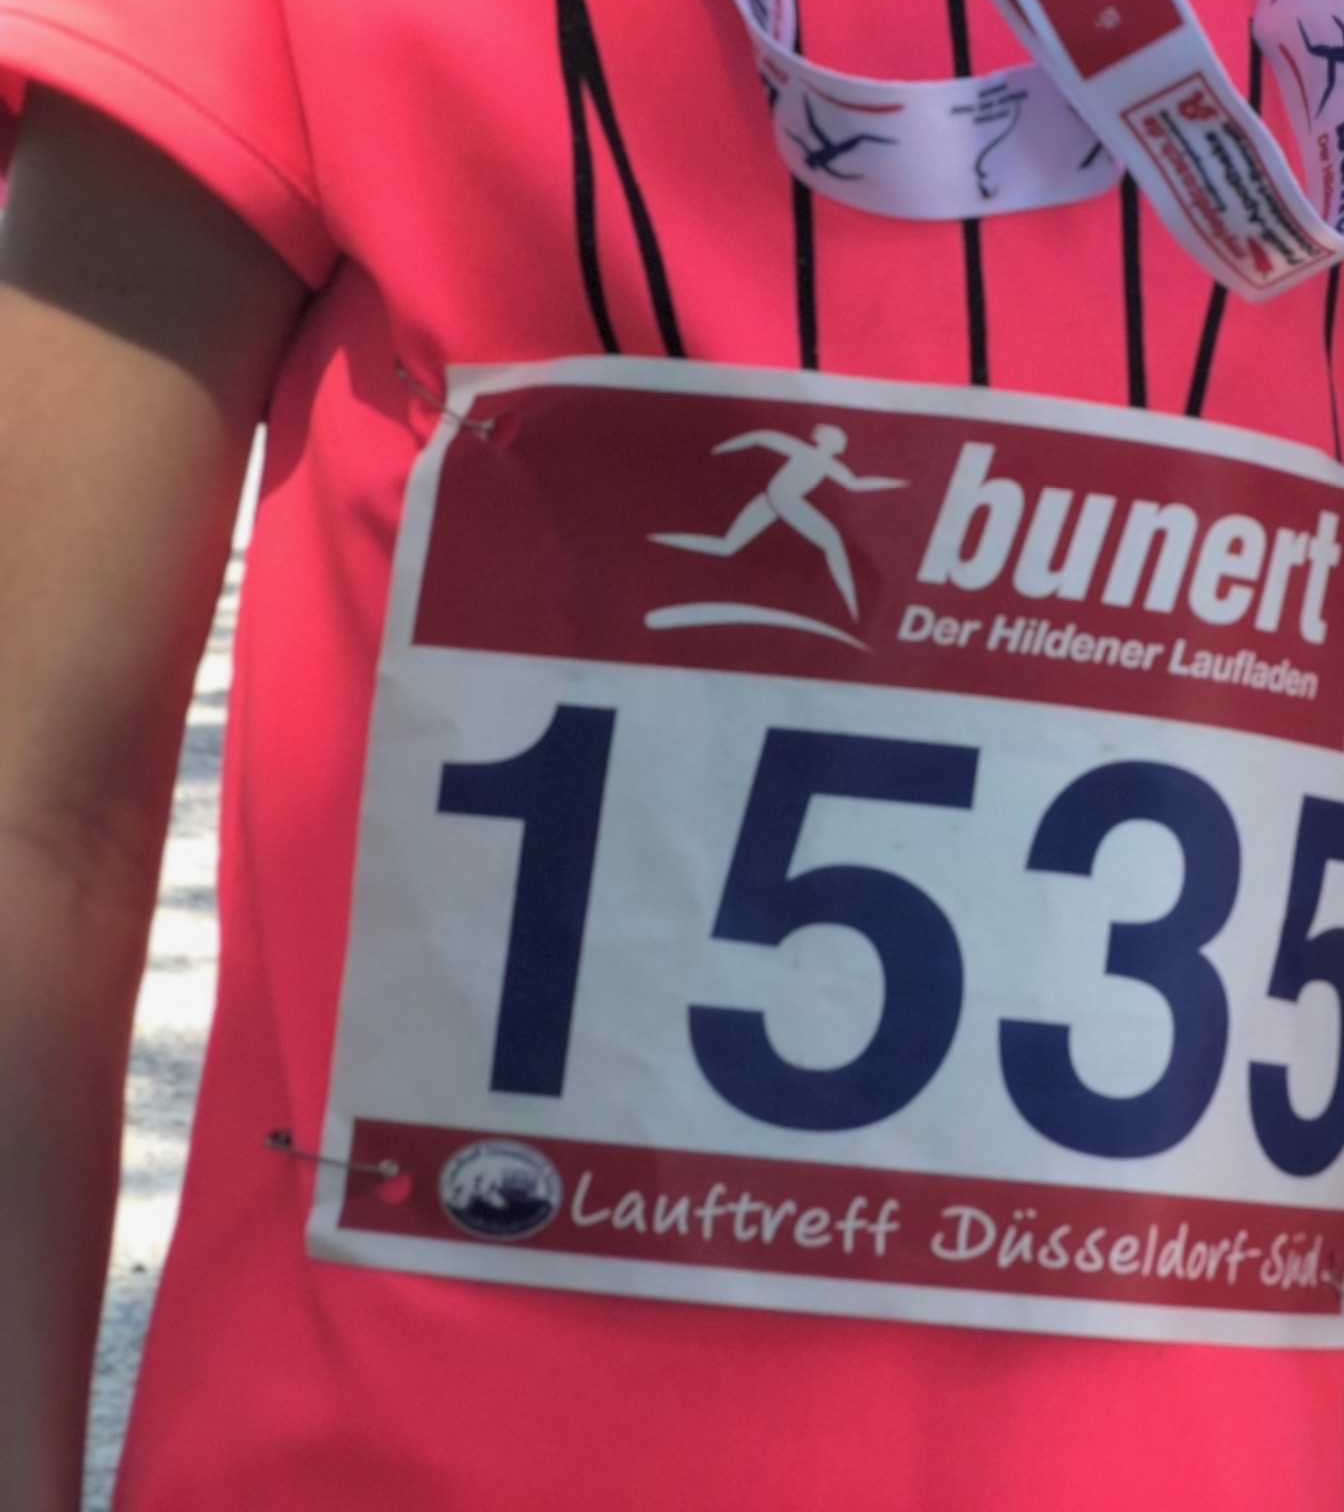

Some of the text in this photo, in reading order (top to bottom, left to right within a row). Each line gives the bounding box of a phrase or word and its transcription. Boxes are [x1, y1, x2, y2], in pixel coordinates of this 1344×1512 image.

[916, 441, 1341, 645] bunert
[897, 604, 1318, 700] Der Hildener Laufladen
[570, 1171, 900, 1258] Lauftreff
